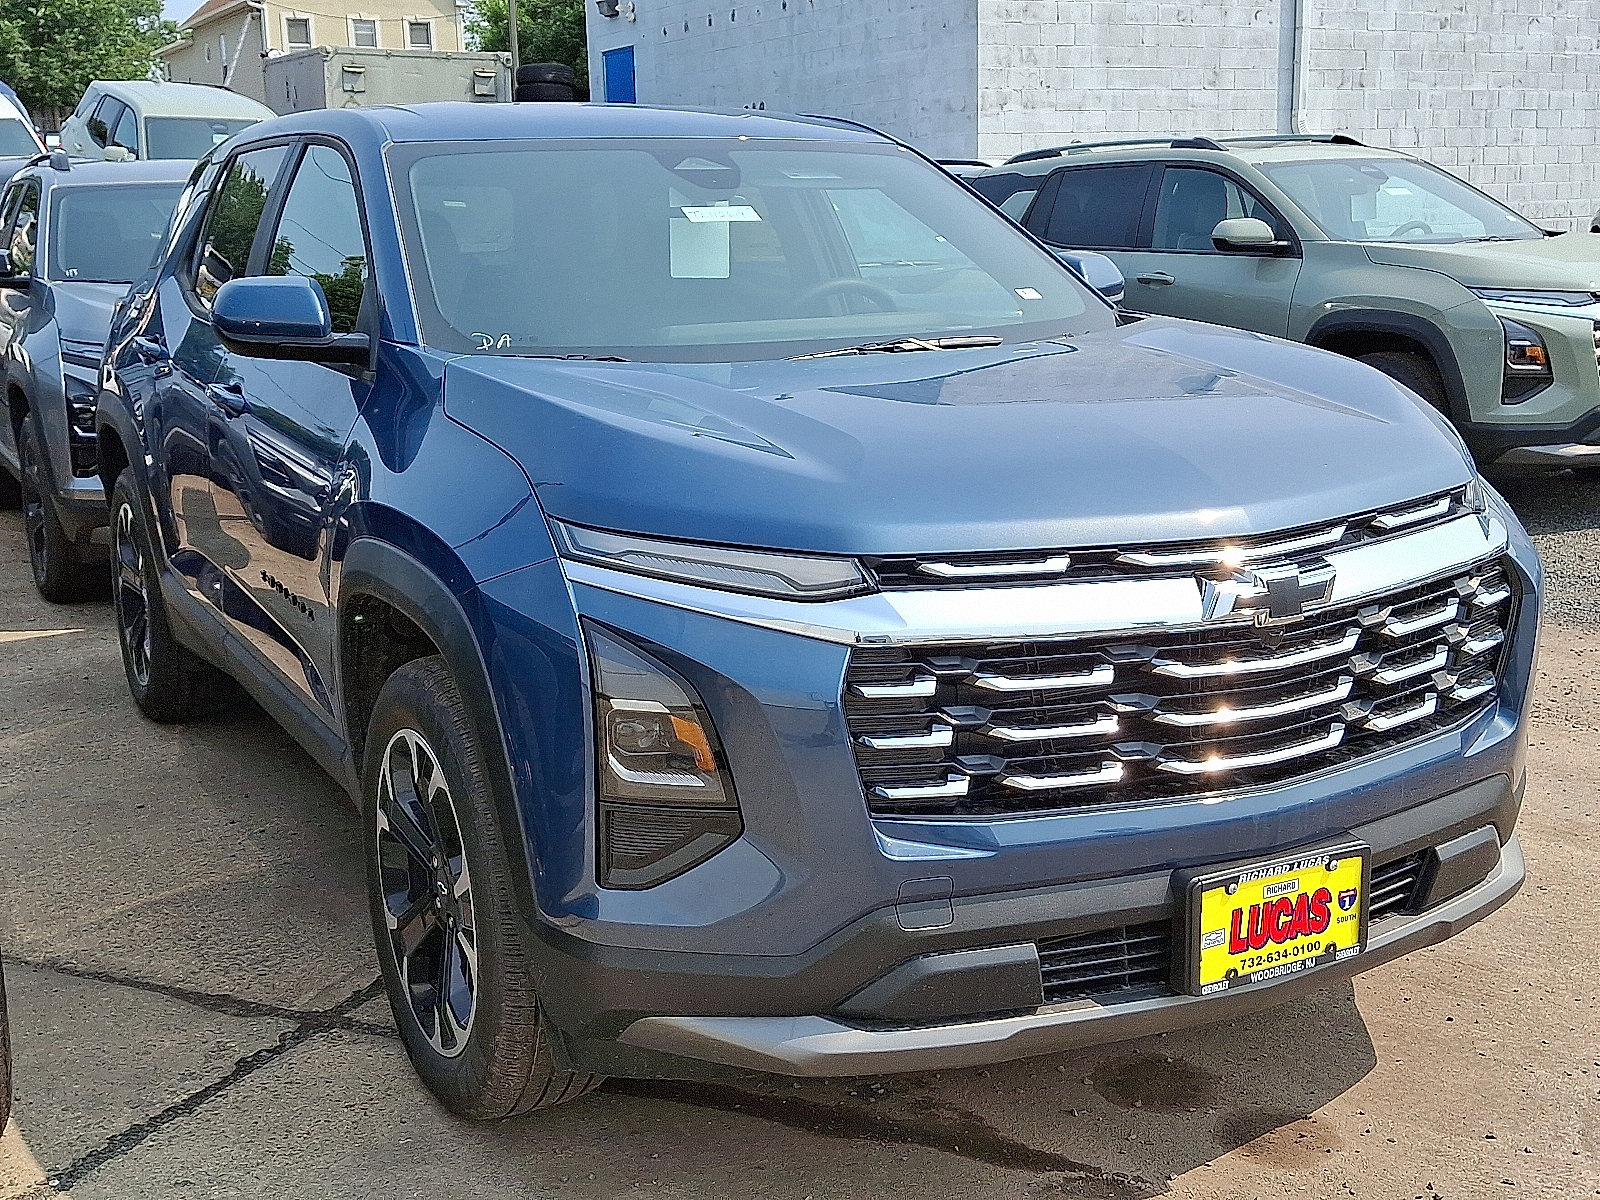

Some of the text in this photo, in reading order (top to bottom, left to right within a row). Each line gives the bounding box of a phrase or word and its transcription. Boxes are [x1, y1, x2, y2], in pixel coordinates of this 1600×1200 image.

[1238, 855, 1331, 883] RICHARD LUCAS
[1266, 881, 1297, 895] RICHARD
[1229, 887, 1333, 955] LUCAS
[1336, 913, 1357, 924] SOUTH
[1305, 957, 1315, 968] NJ
